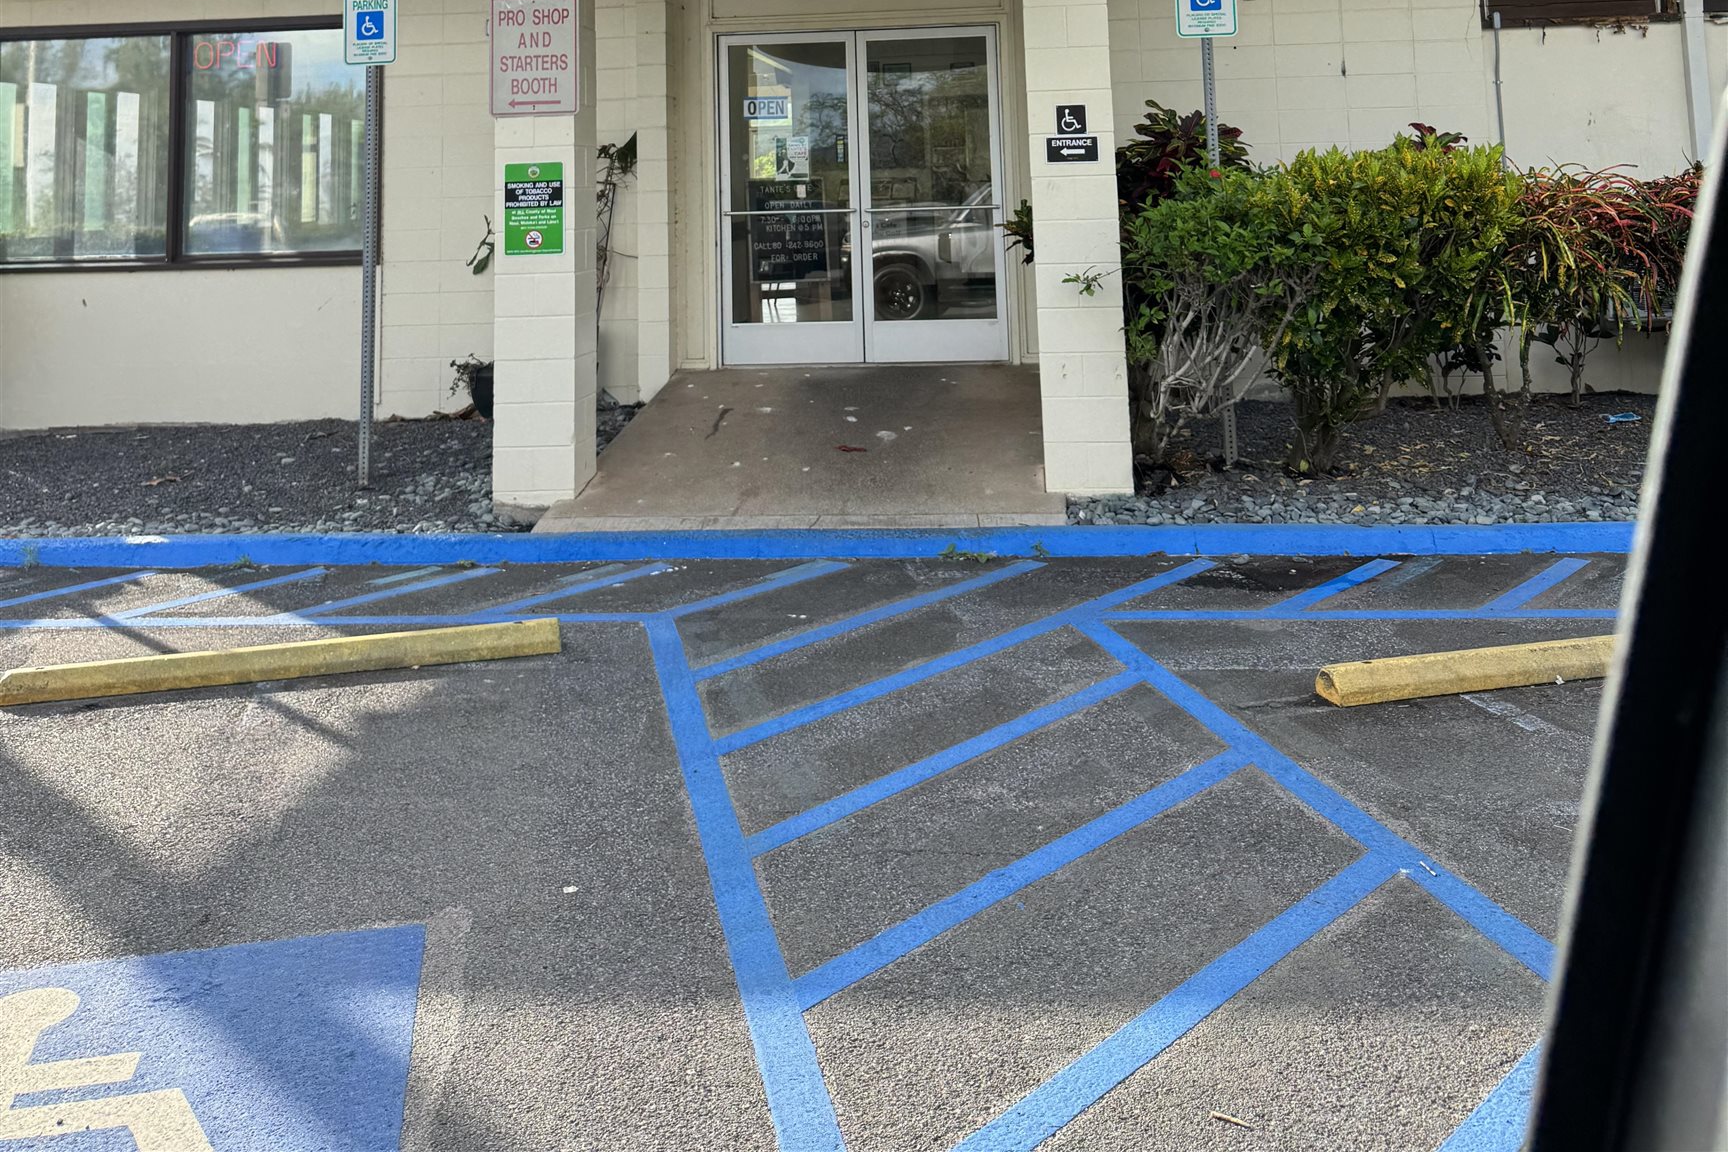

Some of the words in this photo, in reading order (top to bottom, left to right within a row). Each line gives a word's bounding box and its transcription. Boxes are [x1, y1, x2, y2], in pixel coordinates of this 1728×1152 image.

[352, 0, 389, 11] PARKING
[498, 9, 526, 26] PRO
[532, 8, 570, 25] SHOP
[518, 31, 552, 49] AND
[194, 40, 277, 69] OPEN
[500, 53, 568, 72] STARTERS
[511, 77, 557, 95] BOOTH
[747, 100, 784, 115] OPEN
[1051, 139, 1092, 147] ENTRANCE
[764, 201, 785, 209] OPEN
[790, 201, 812, 209] DAILY
[793, 253, 818, 261] ORDER
